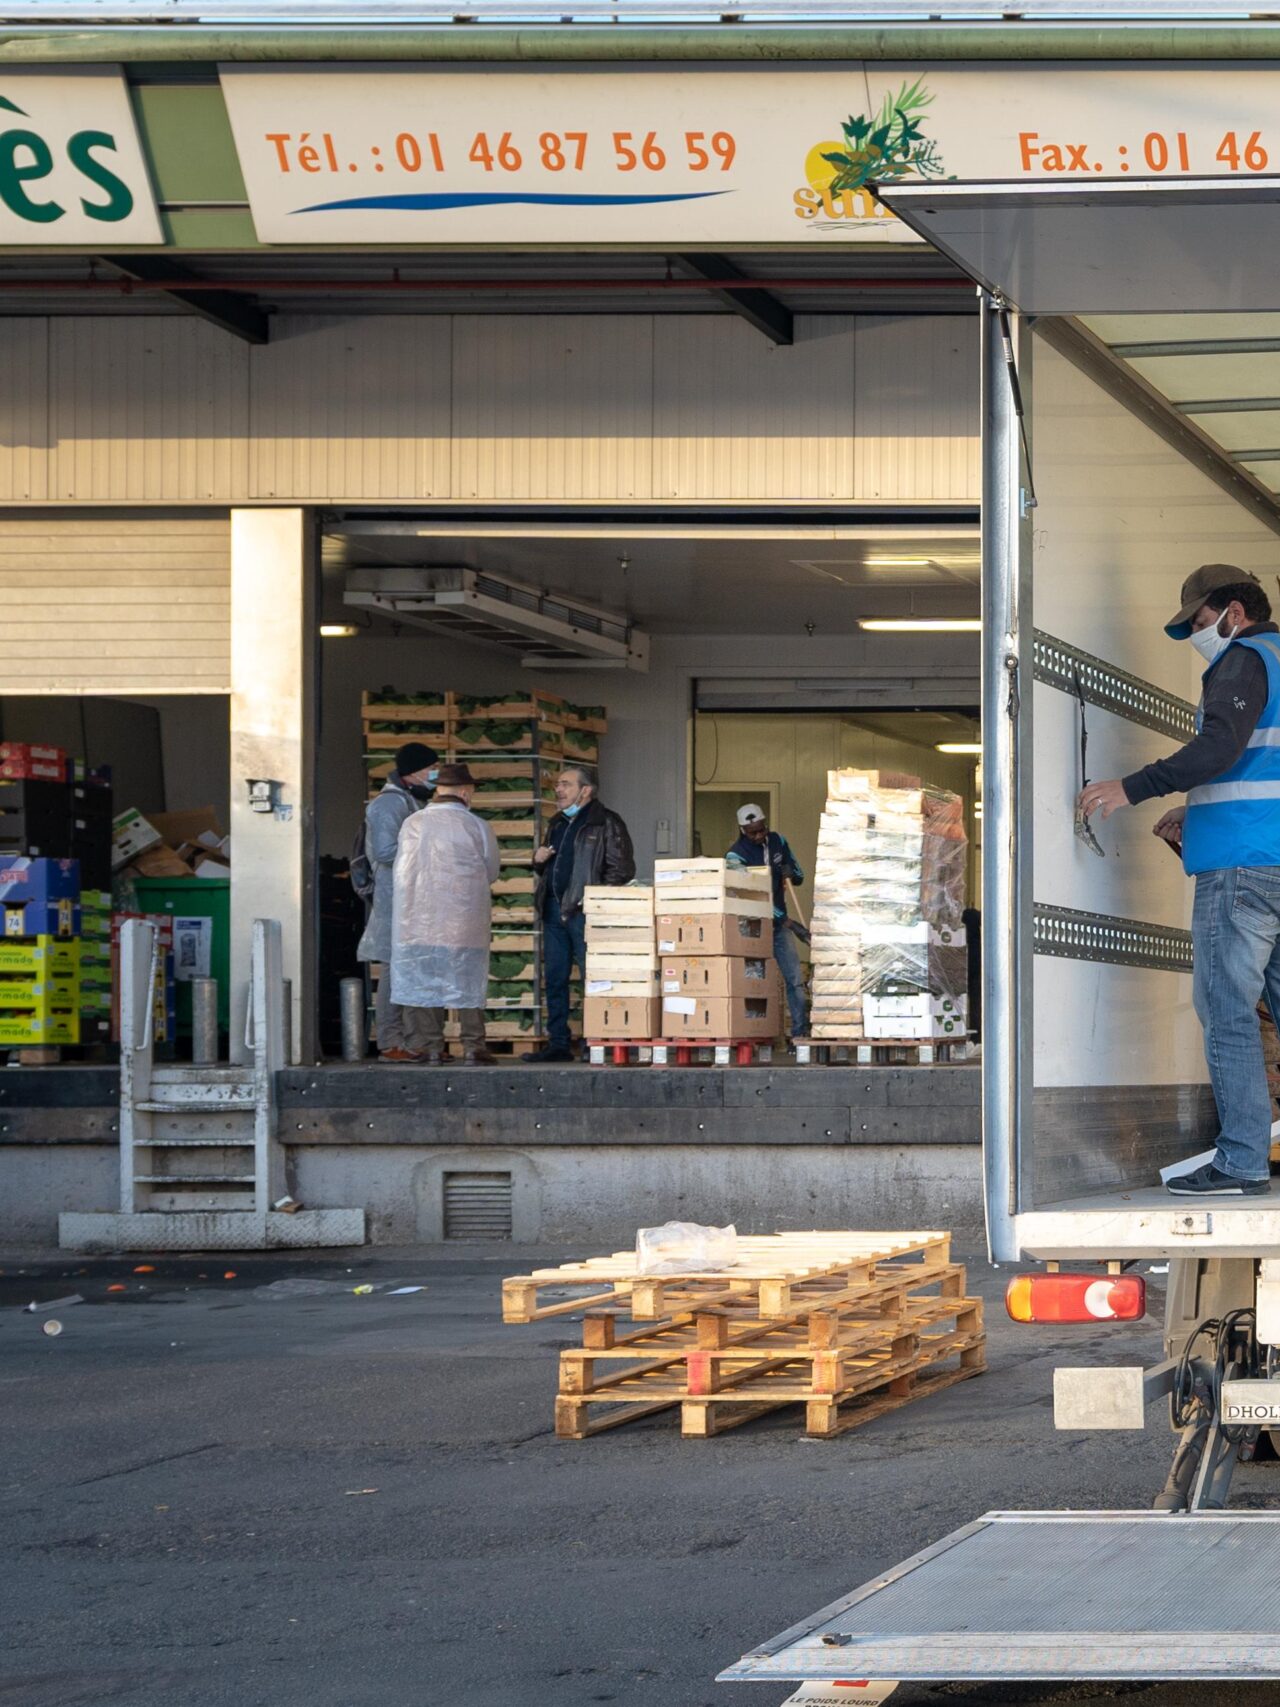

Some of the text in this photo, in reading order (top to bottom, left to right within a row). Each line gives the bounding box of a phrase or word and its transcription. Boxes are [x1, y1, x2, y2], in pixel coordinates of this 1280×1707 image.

[396, 132, 444, 172] 01
[468, 132, 523, 172] 46
[539, 131, 588, 172] 87
[612, 132, 667, 172] 56
[684, 131, 737, 172] 59
[1143, 132, 1190, 172] 01
[1215, 131, 1269, 172] 46
[805, 1697, 840, 1705] POIDS
[840, 1698, 879, 1706] LOURD
